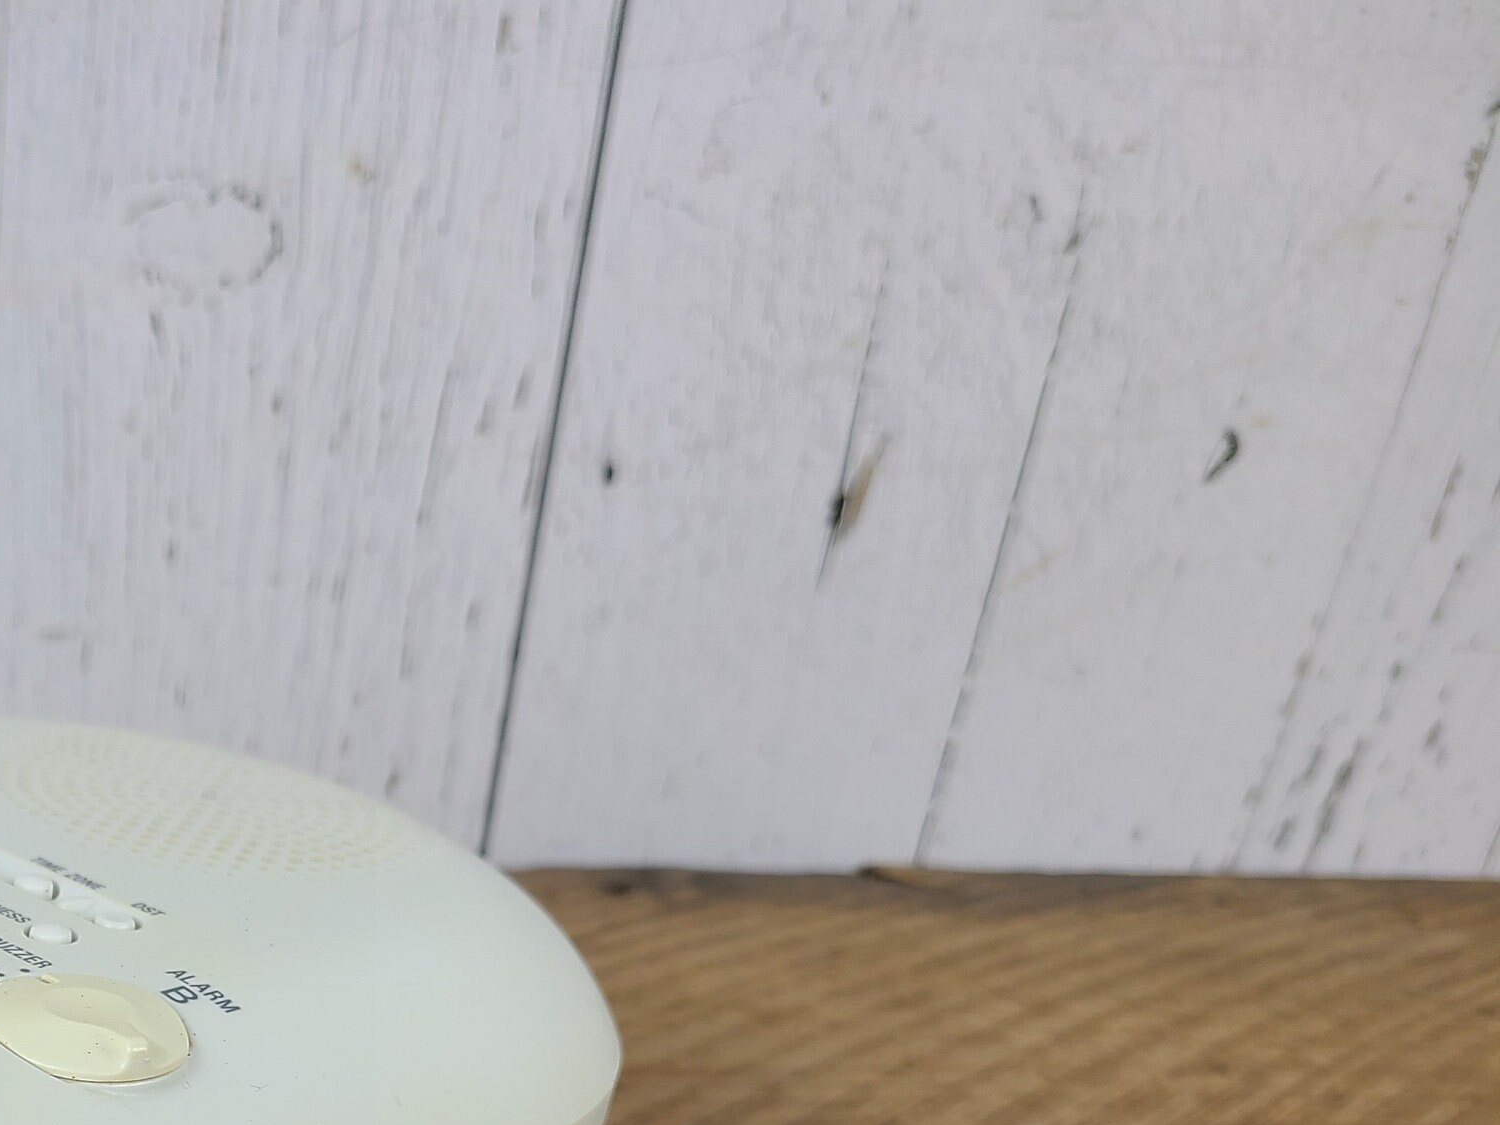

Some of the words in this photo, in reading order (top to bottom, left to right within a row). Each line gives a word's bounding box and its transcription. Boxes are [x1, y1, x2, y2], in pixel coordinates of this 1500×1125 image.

[64, 872, 107, 890] ZONE
[131, 902, 167, 917] DST
[159, 985, 198, 1004] B
[165, 969, 242, 1014] ALARM
